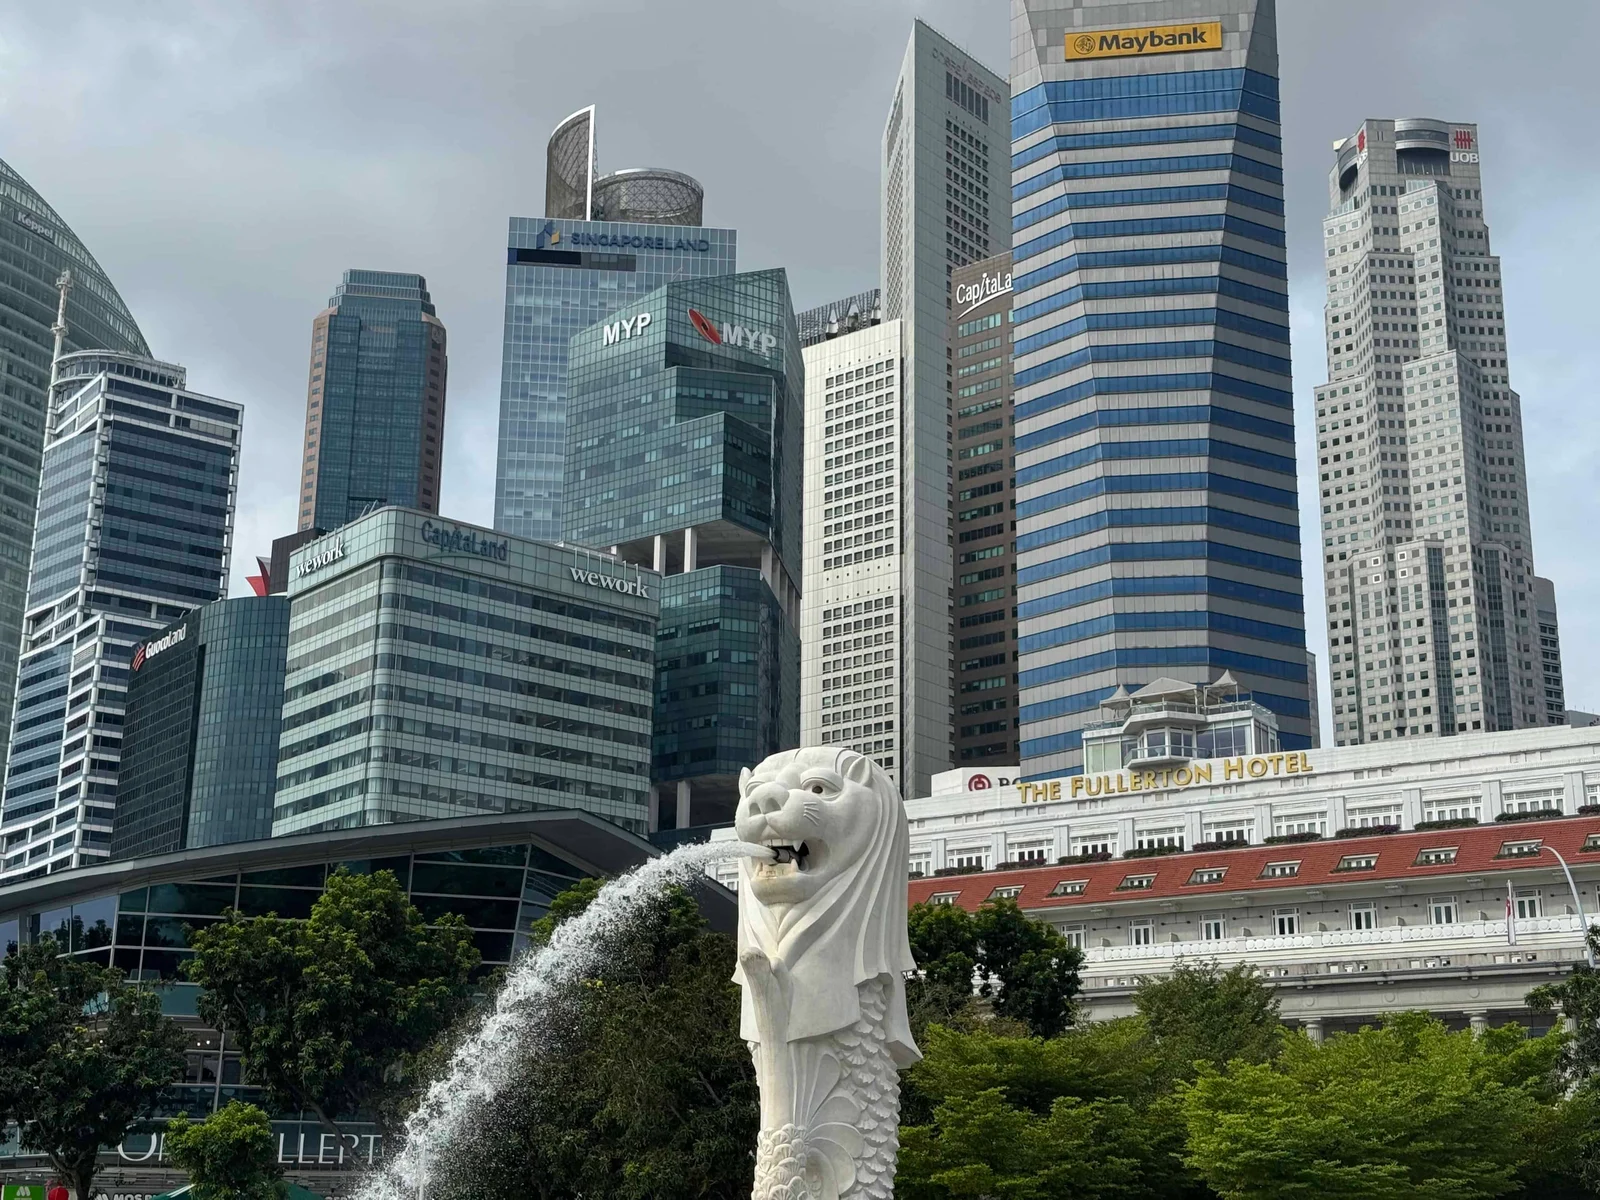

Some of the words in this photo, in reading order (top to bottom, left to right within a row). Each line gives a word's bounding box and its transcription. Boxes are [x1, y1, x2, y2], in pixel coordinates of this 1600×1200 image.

[1099, 27, 1207, 52] Maybank
[1449, 151, 1479, 163] UOB
[17, 211, 53, 239] Keppel
[956, 271, 1012, 305] CapitaLa
[603, 312, 651, 346] MYP
[722, 322, 777, 352] MYP
[296, 536, 345, 578] wework
[421, 520, 508, 561] CapitaLand
[569, 567, 650, 598] wework
[145, 622, 187, 659] GuocoLand
[1016, 781, 1061, 804] THE
[1070, 762, 1212, 797] FULLERTON
[1223, 751, 1313, 781] HOTEL
